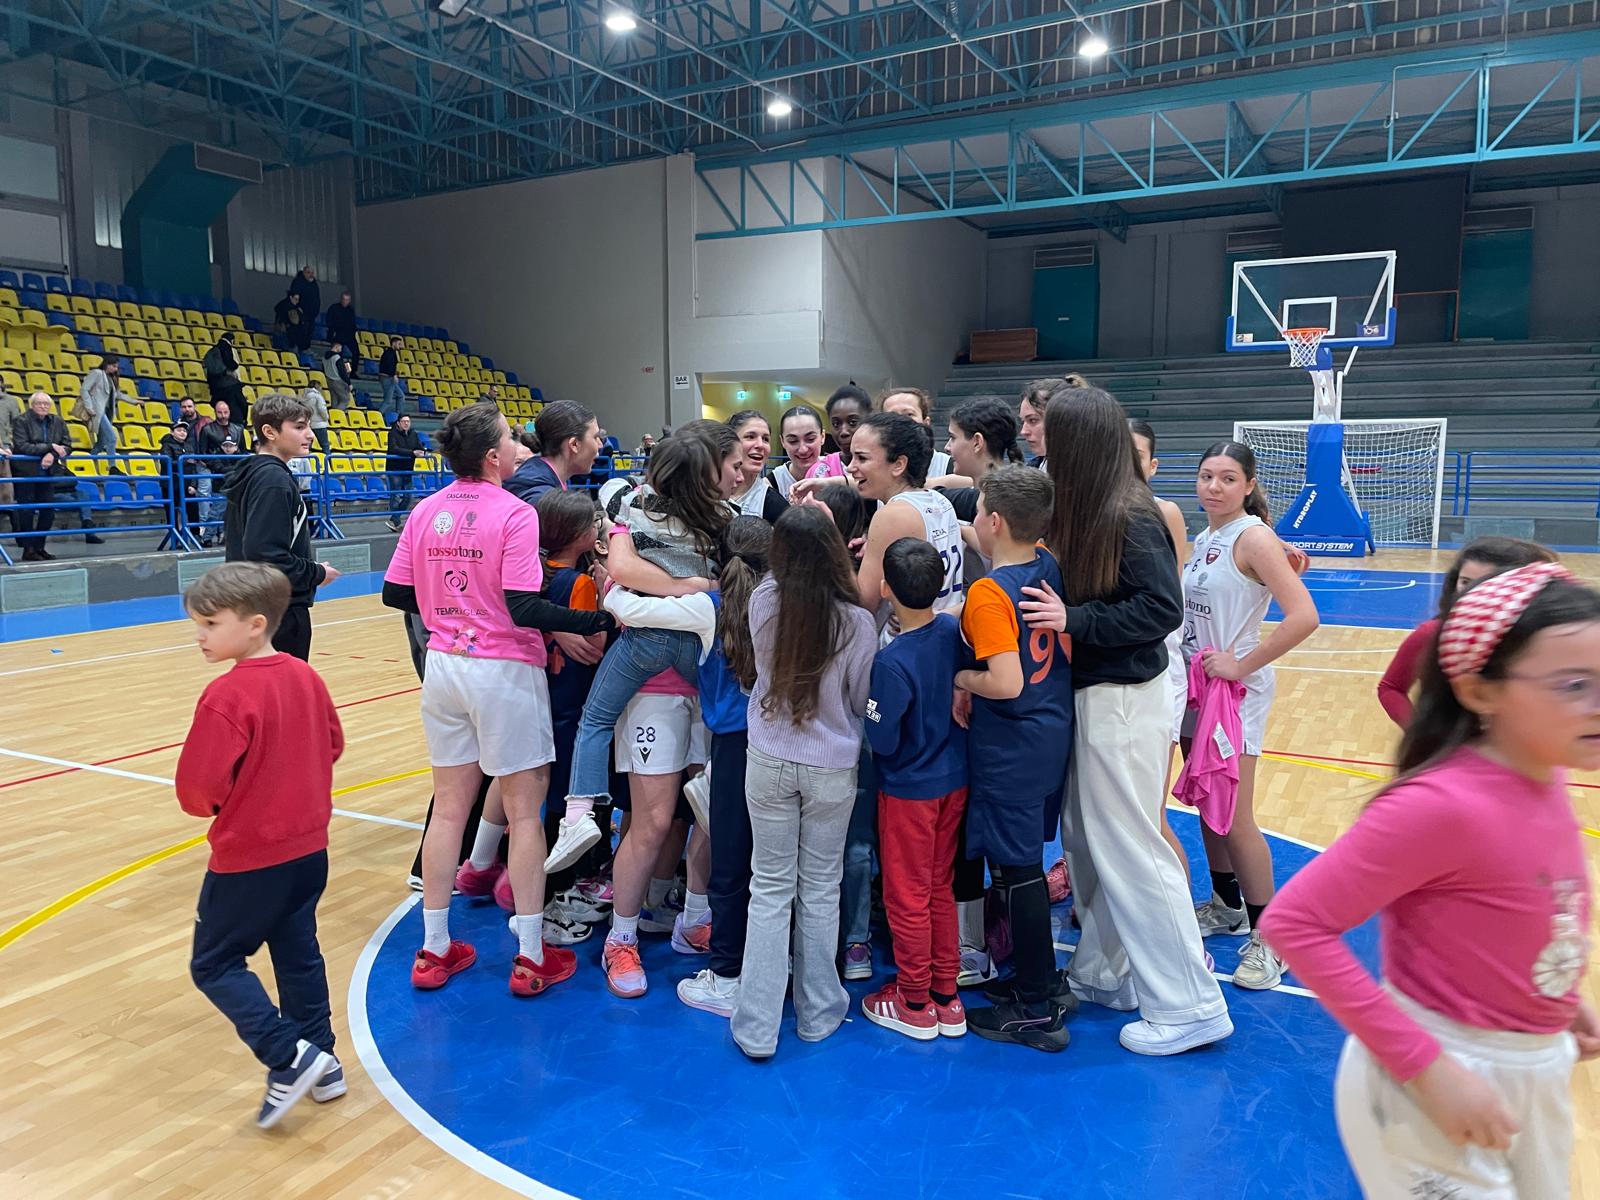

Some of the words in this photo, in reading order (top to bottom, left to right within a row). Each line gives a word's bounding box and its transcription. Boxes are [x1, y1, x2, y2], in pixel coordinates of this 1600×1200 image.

[1293, 490, 1317, 528] HYDROPLAY
[427, 546, 483, 559] rossotono
[1192, 559, 1201, 572] 6
[636, 727, 656, 743] 28
